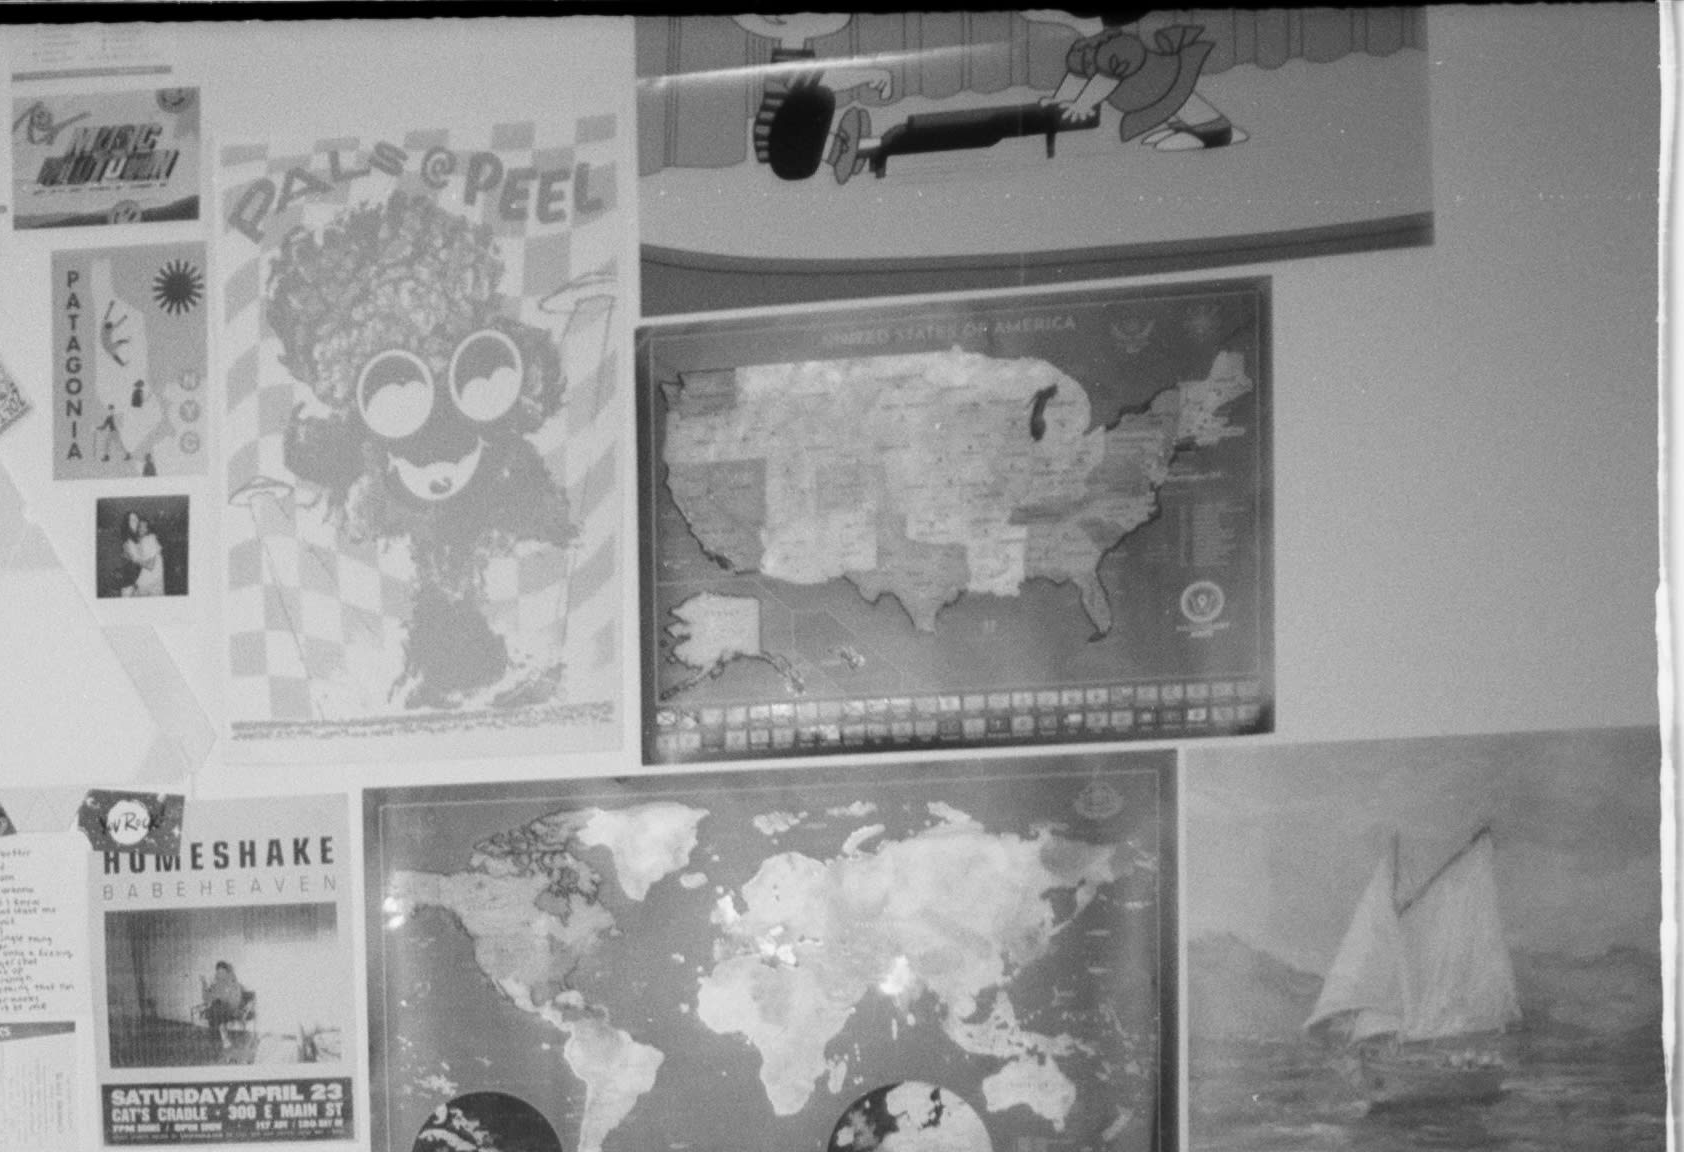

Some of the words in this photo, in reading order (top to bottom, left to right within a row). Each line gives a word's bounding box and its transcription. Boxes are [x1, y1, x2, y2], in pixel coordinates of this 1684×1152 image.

[227, 140, 408, 245] PALS
[463, 150, 606, 225] PEEL
[64, 269, 84, 462] PATAGONIA
[103, 836, 334, 875] HOMESHAKE
[103, 874, 337, 901] BABEHEAVEN
[111, 1086, 229, 1107] SATURDAY
[235, 1084, 304, 1103] APRIL
[310, 1083, 343, 1101] 23
[112, 1107, 150, 1123] CAT'S
[157, 1106, 208, 1121] CRADLE
[228, 1104, 256, 1121] 300
[264, 1104, 272, 1119] E
[280, 1103, 317, 1119] MAIN
[325, 1102, 343, 1117] ST
